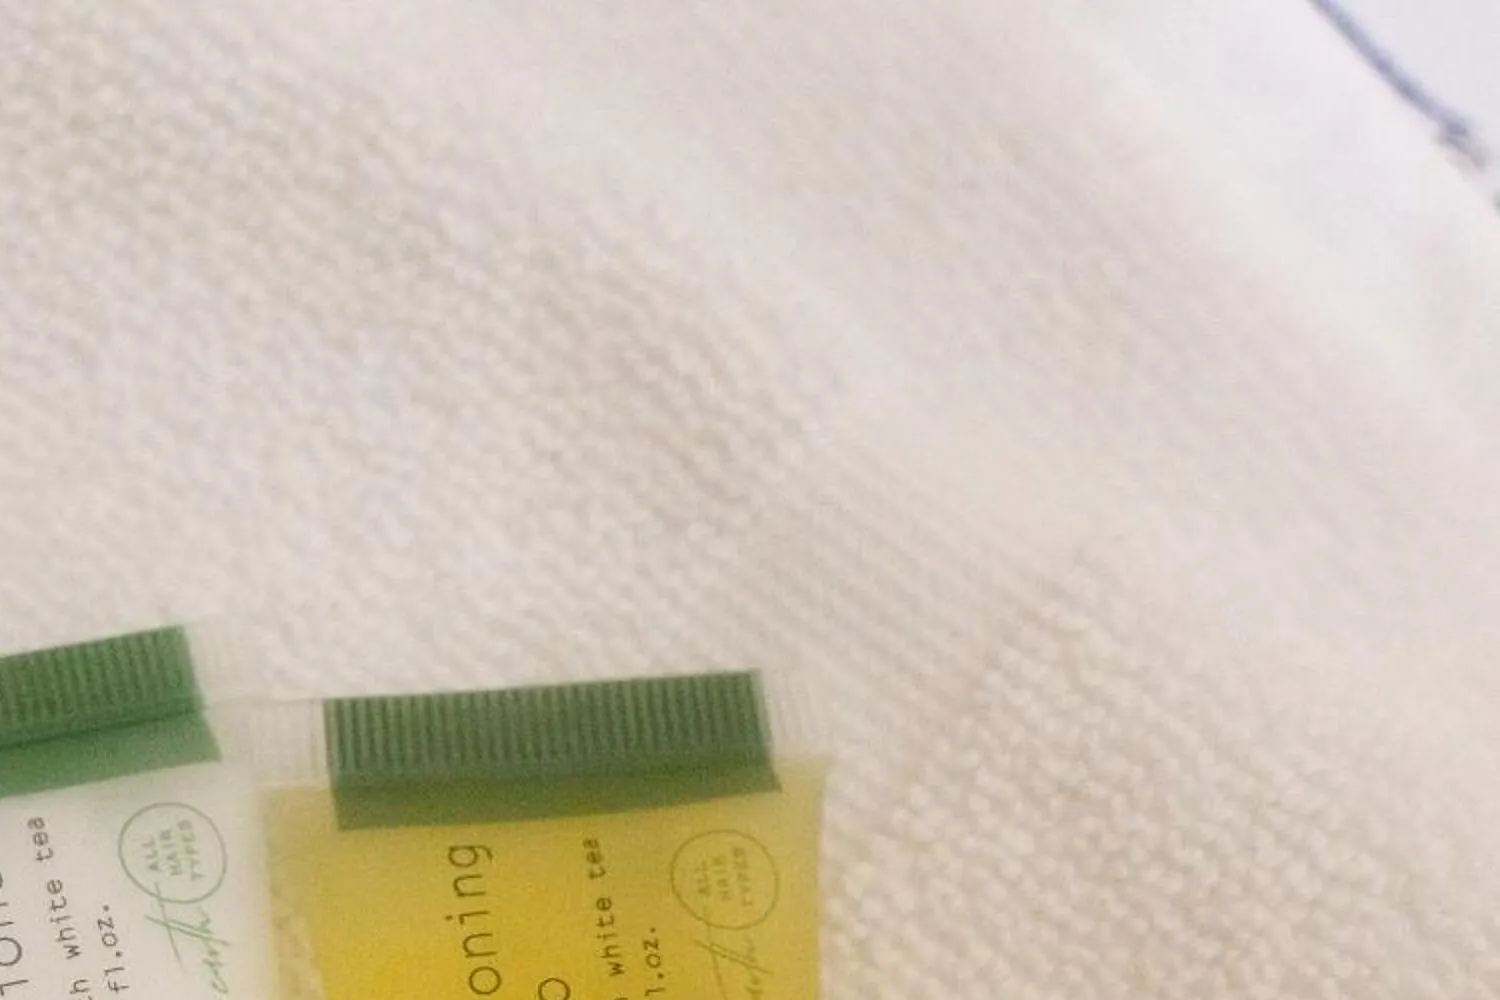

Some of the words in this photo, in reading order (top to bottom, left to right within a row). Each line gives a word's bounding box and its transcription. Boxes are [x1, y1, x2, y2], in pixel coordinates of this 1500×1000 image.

[27, 817, 54, 862] tea
[142, 838, 162, 872] ALL
[159, 829, 183, 876] HAIR
[177, 820, 204, 882] TYPES
[583, 836, 606, 880] tea
[46, 880, 81, 959] white
[596, 897, 624, 977] white
